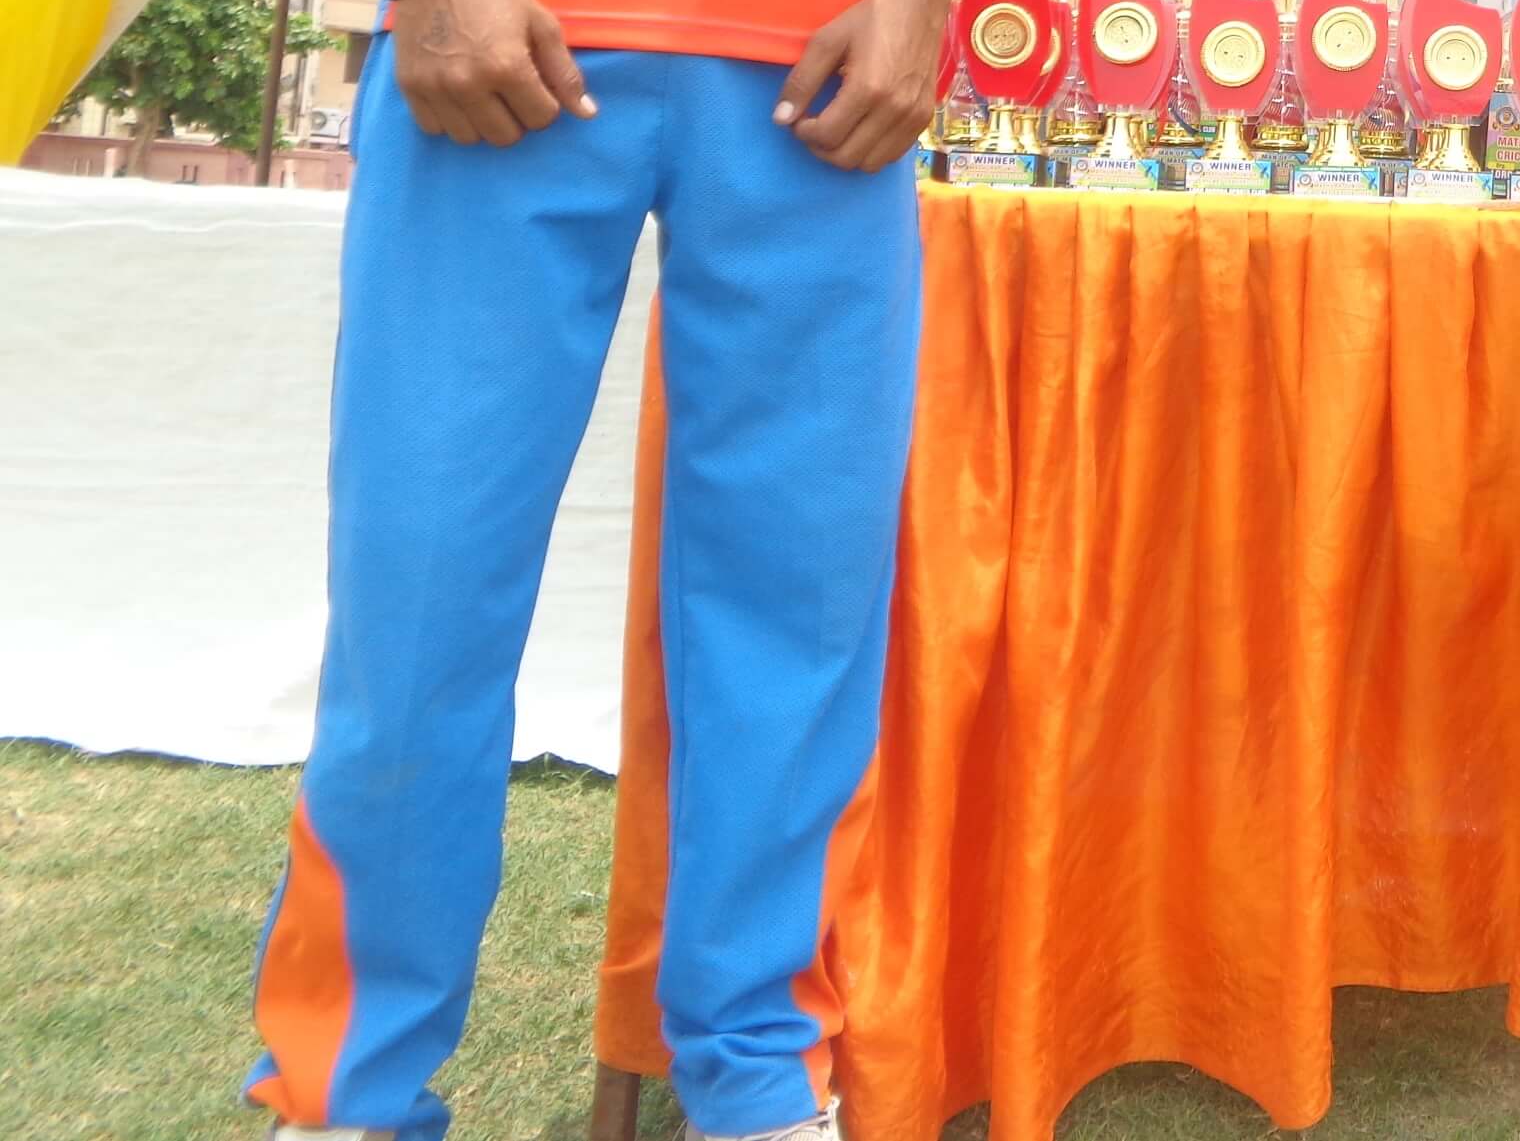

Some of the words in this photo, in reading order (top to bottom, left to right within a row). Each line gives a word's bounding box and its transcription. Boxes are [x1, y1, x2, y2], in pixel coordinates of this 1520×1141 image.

[974, 155, 1016, 166] WINNER
[1094, 159, 1137, 170] WINNER
[1210, 161, 1252, 172] WINNER
[1318, 173, 1360, 184] WINNER
[1431, 173, 1474, 183] WINNER
